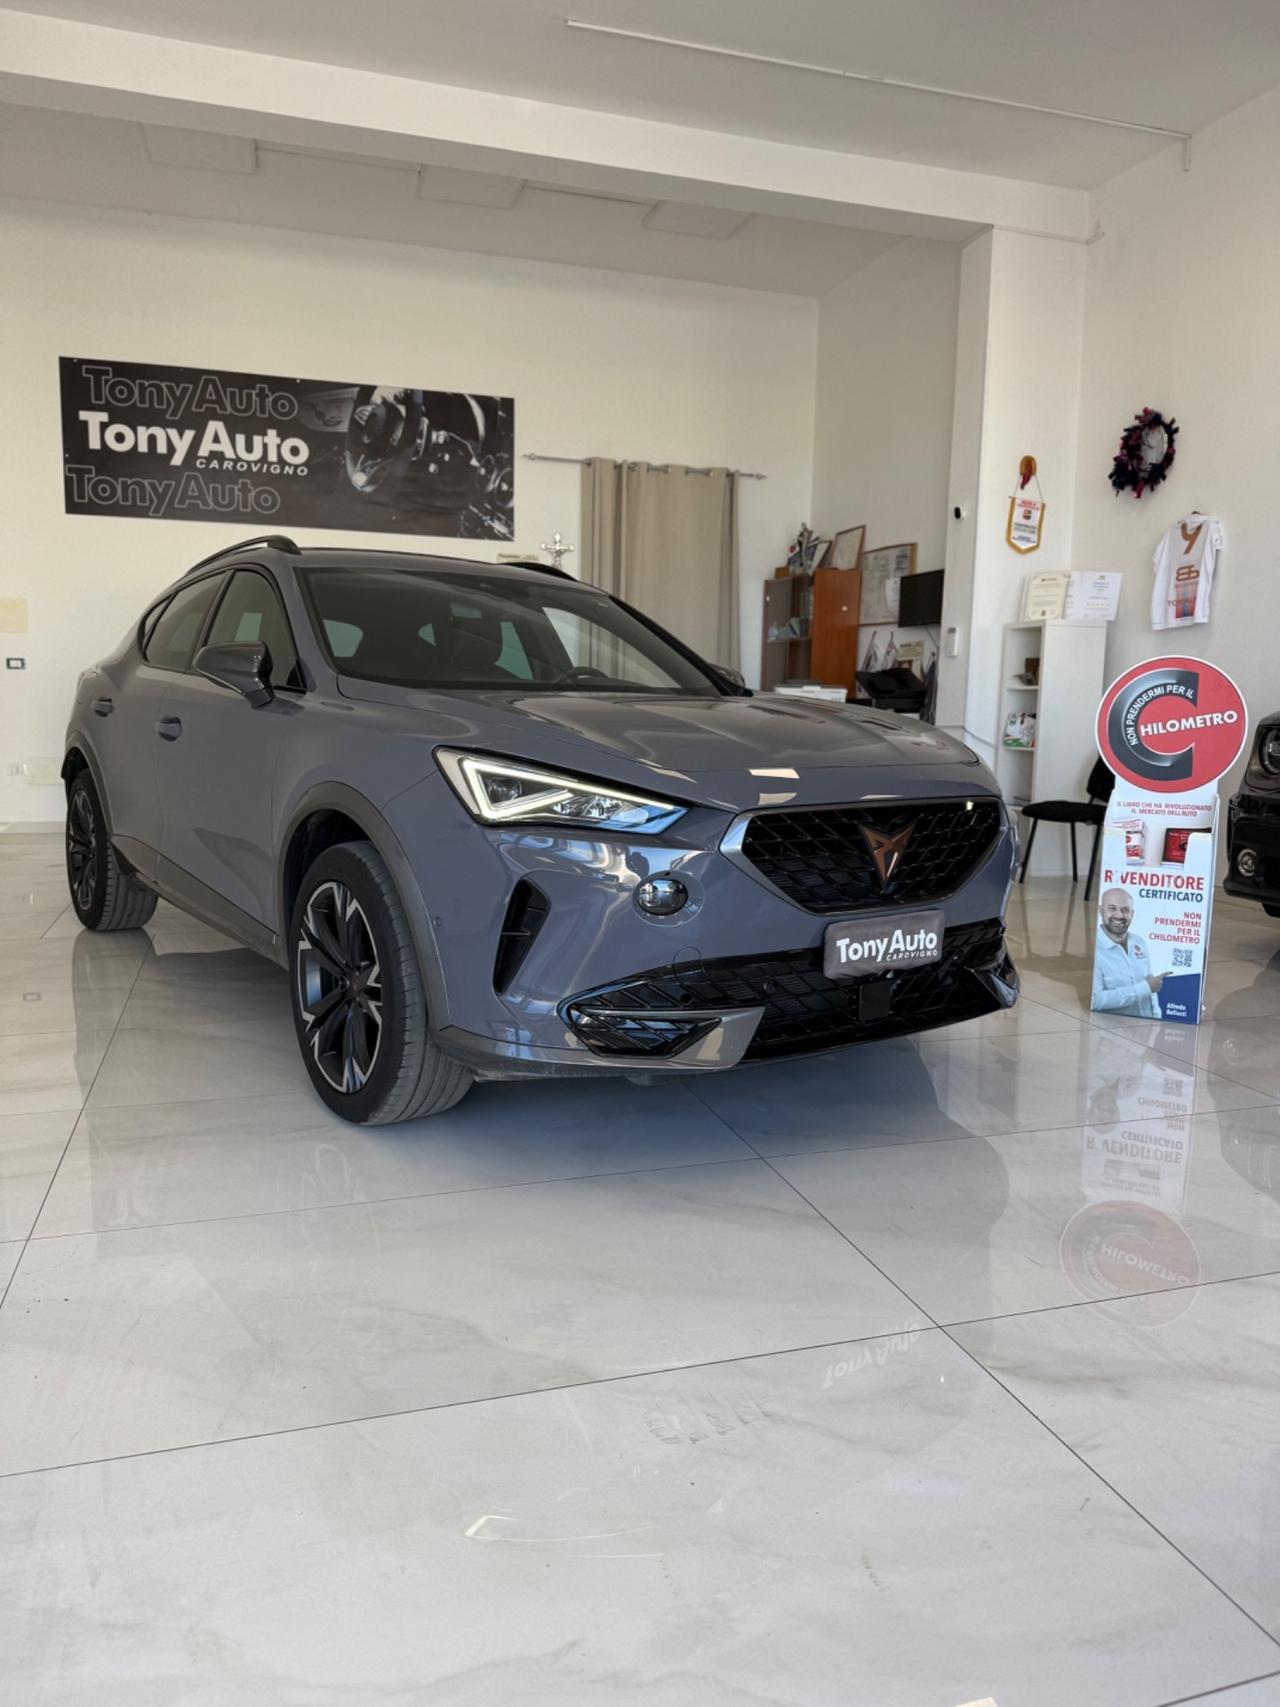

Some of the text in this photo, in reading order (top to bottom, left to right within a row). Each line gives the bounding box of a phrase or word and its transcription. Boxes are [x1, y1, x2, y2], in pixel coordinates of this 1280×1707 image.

[196, 458, 309, 476] CAROVIGNO
[1126, 684, 1194, 746] NON PRENDERMI PER IL
[1104, 870, 1205, 891] RVENDITORE
[1139, 888, 1204, 903] CERTIFICATO
[1184, 911, 1202, 920] NON
[1155, 917, 1202, 928] PRENDERMI
[1149, 932, 1200, 945] CHILOMETRO
[1177, 928, 1201, 937] PER IL
[886, 949, 938, 961] CAROVIGNO
